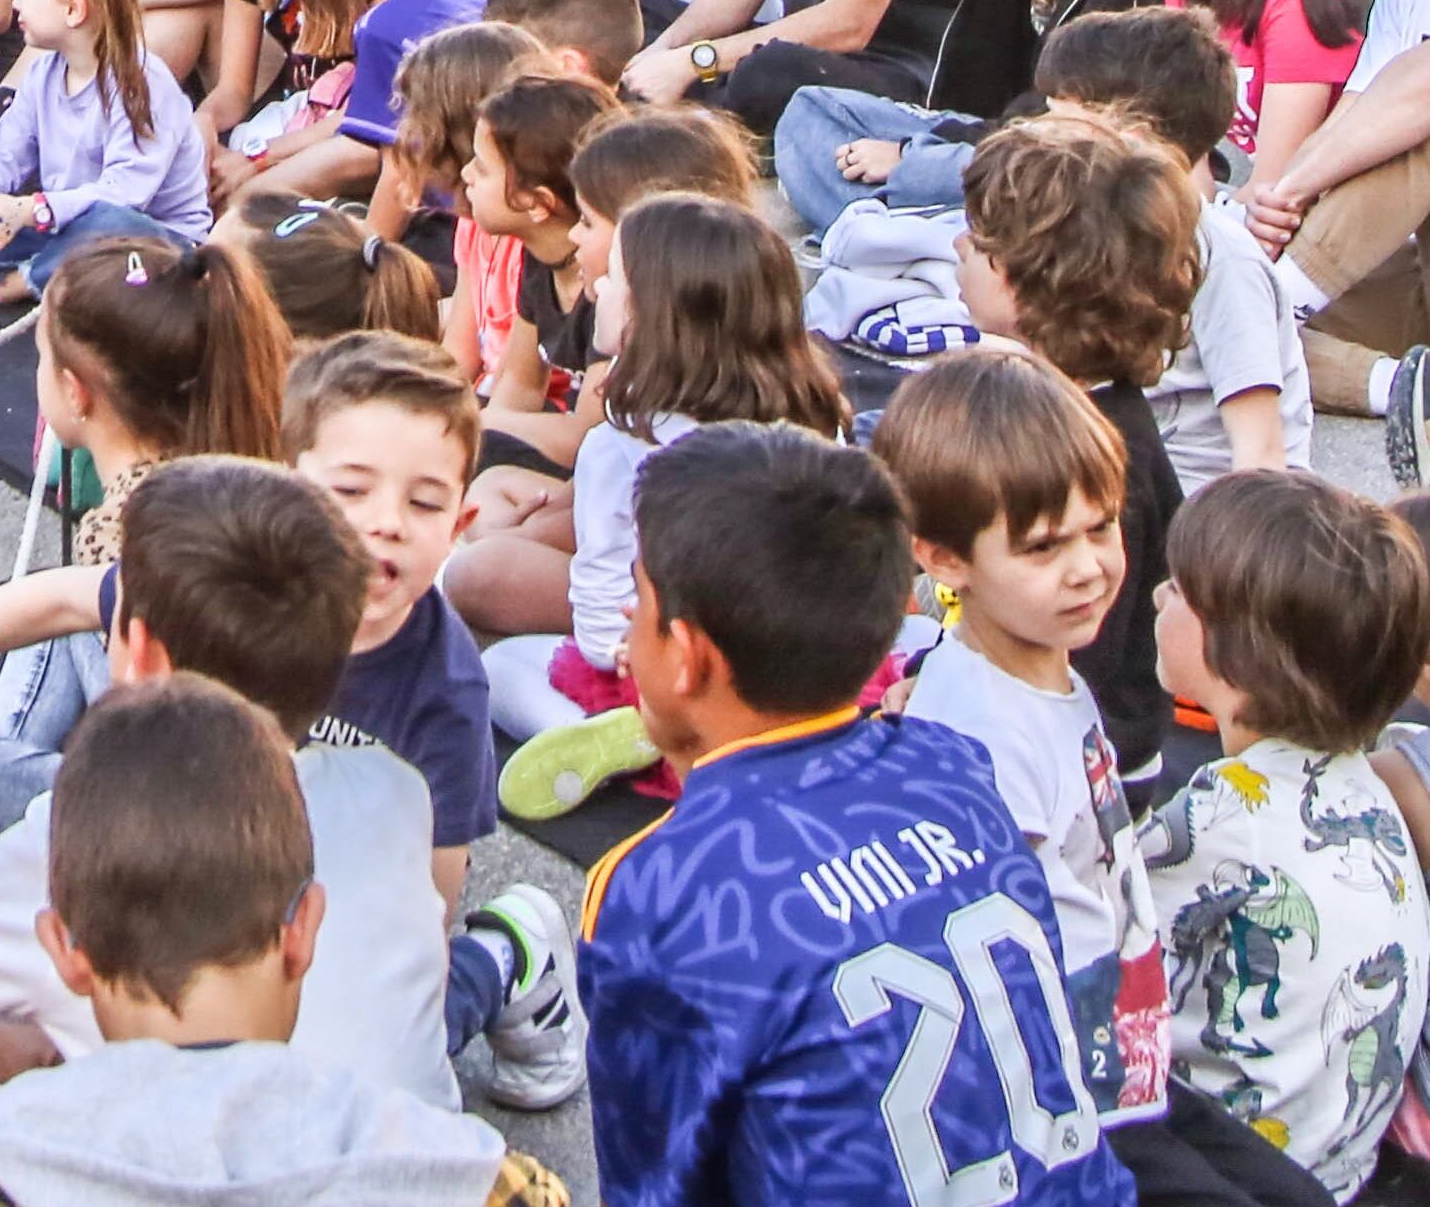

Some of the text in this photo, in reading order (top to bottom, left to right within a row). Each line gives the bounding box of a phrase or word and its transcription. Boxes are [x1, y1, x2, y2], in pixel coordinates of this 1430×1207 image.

[308, 715, 381, 746] UNIT
[799, 840, 918, 925] VINI
[831, 891, 1100, 1207] 20
